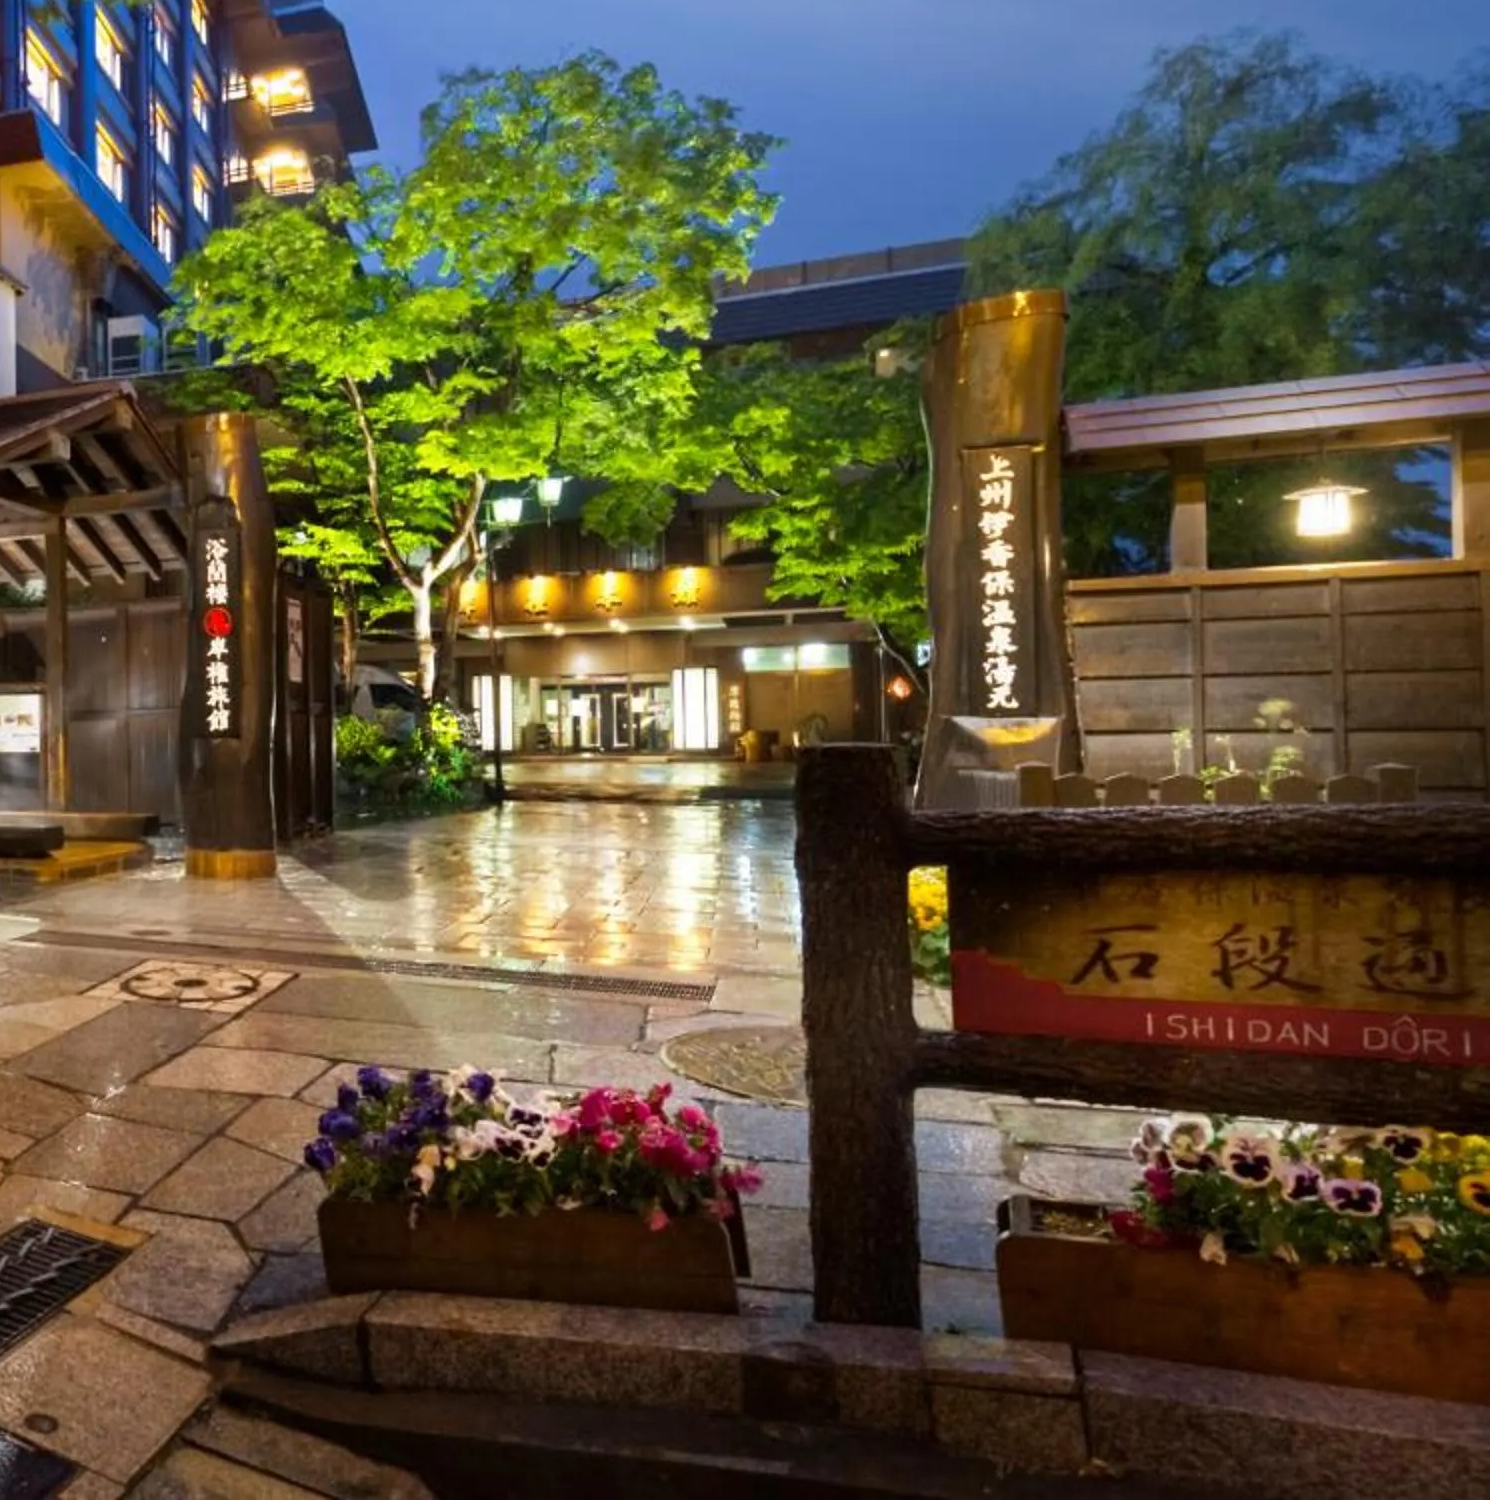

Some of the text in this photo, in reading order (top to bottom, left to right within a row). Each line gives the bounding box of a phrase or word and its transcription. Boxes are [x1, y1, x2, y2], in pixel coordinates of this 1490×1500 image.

[1070, 921, 1478, 997] 石段通
[1145, 1011, 1473, 1058] ISHIDAN DÔRI
